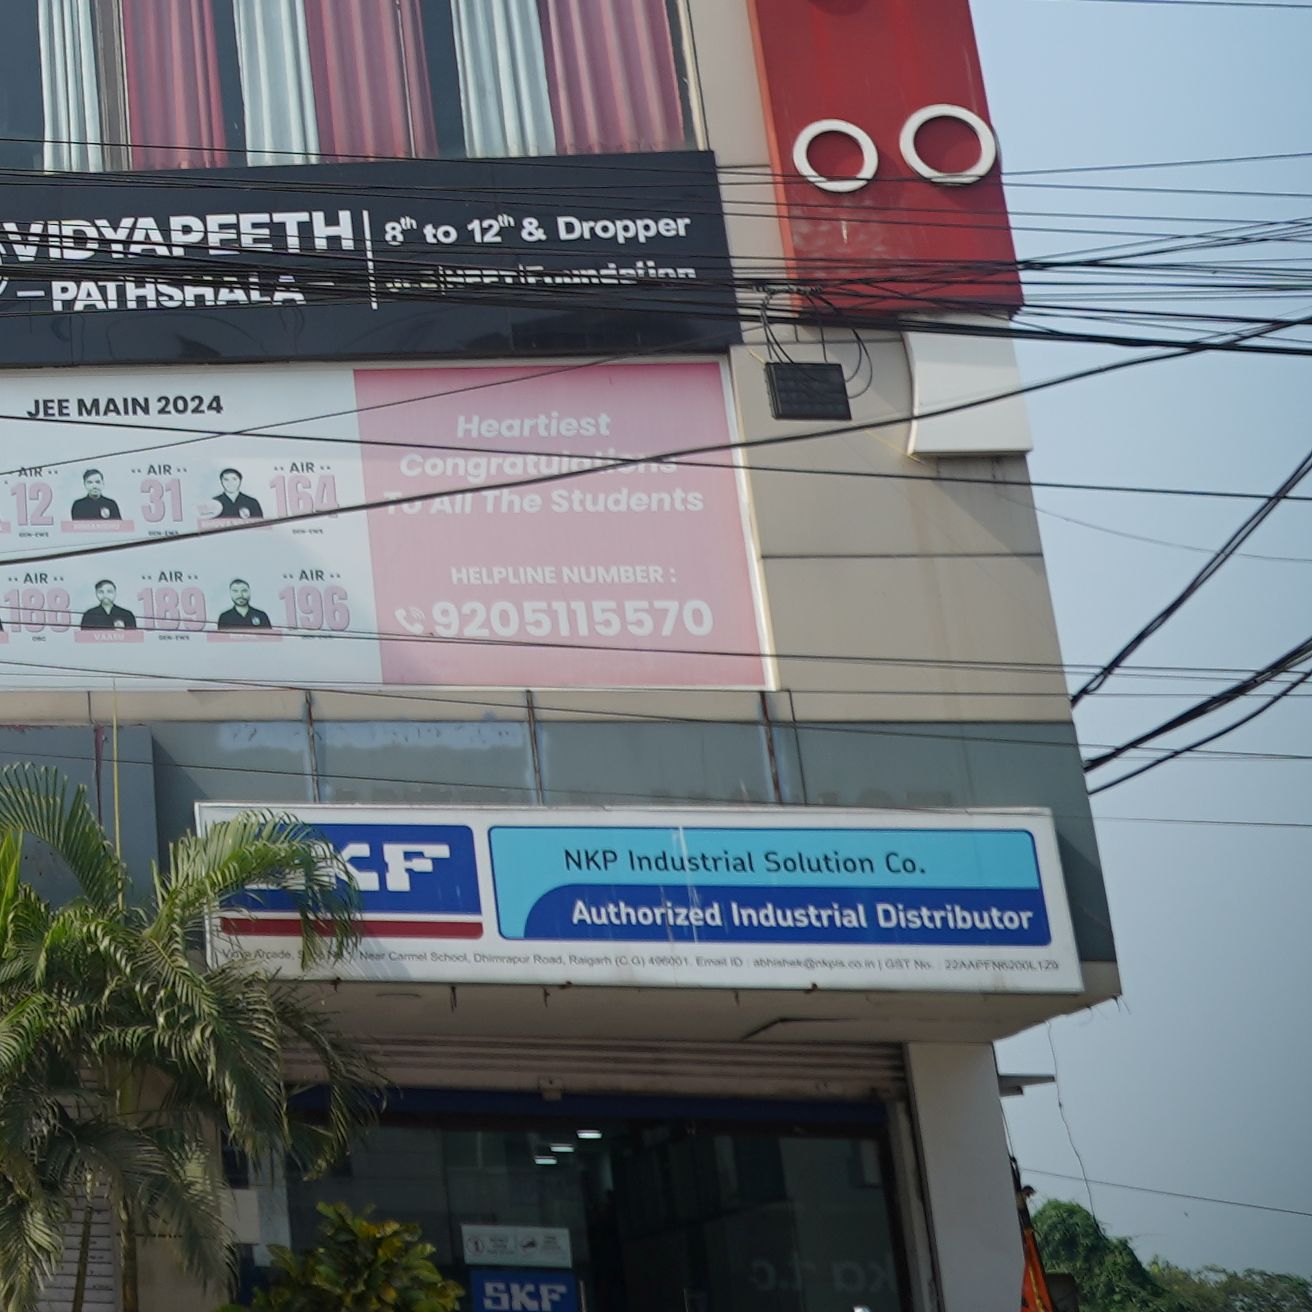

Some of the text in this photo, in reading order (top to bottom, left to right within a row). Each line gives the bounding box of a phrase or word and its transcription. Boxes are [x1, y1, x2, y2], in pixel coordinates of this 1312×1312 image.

[3, 210, 354, 261] VIDYAPEETH
[424, 224, 458, 244] to
[467, 214, 515, 244] 12th
[521, 217, 546, 243] &
[557, 216, 691, 244] Dropper
[51, 275, 306, 312] PATHSHALA
[26, 395, 224, 417] JEE MAIN 2024
[457, 411, 611, 438] Heartiest
[18, 467, 43, 477] AIR
[147, 464, 172, 475] AIR
[290, 462, 315, 473] AIR
[10, 482, 54, 526] 12
[140, 478, 183, 523] 31
[270, 474, 339, 518] 164
[384, 487, 704, 515] To All The Students
[23, 572, 48, 584] AIR
[159, 570, 184, 583] AIR
[299, 569, 325, 582] AIR
[451, 566, 556, 584] HELPLINE
[562, 565, 664, 584] NUMBER
[4, 587, 71, 633] 188
[136, 587, 207, 632] 189
[278, 586, 350, 631] 196
[432, 599, 713, 637] 9205115570
[564, 849, 927, 875] NKP Industrial Solution Co.
[573, 900, 1033, 931] Authorized Industrial Distributor
[483, 1281, 568, 1312] SKF
